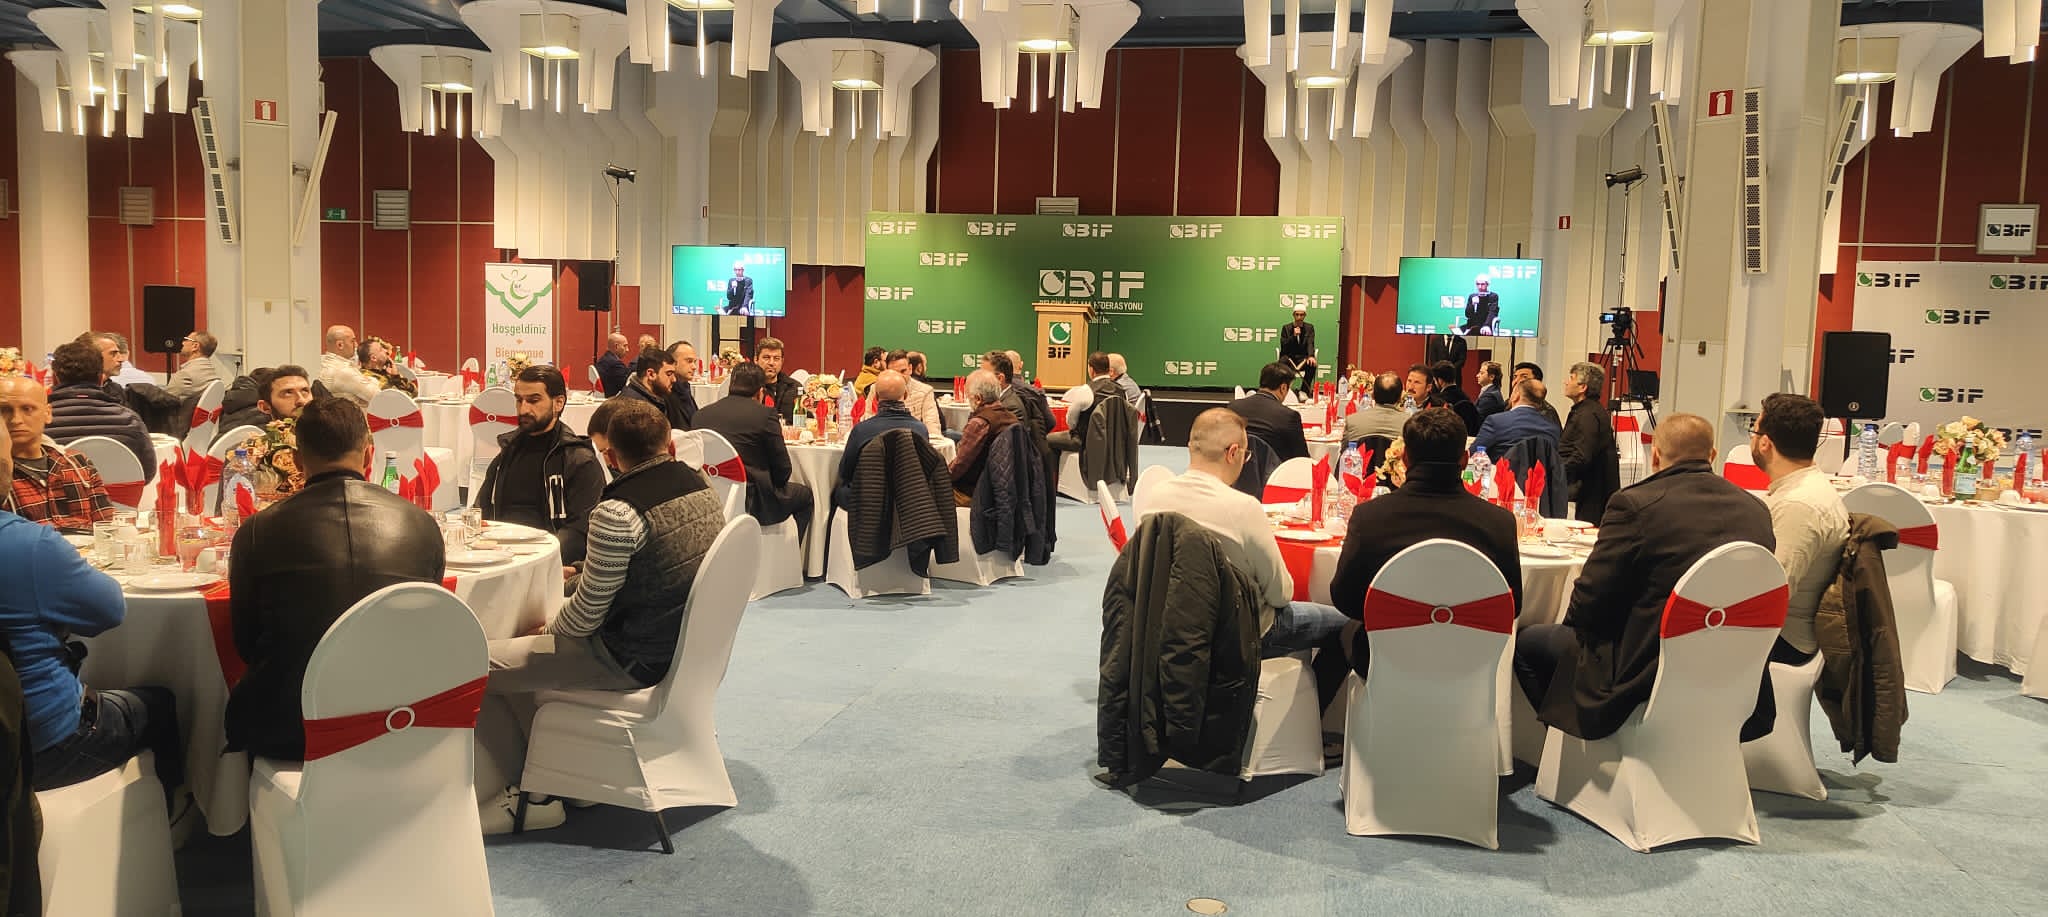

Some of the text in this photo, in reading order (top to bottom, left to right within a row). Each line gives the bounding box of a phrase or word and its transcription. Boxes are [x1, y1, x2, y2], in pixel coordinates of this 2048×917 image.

[2003, 224, 2031, 237] BiF
[1069, 270, 1144, 299] BiF
[1875, 273, 1920, 288] BiF
[1944, 310, 1990, 325] BiF
[493, 322, 546, 336] Hoşgeldiniz
[1048, 347, 1071, 358] BiF
[1889, 349, 1915, 364] iF
[1937, 388, 1984, 403] BiF
